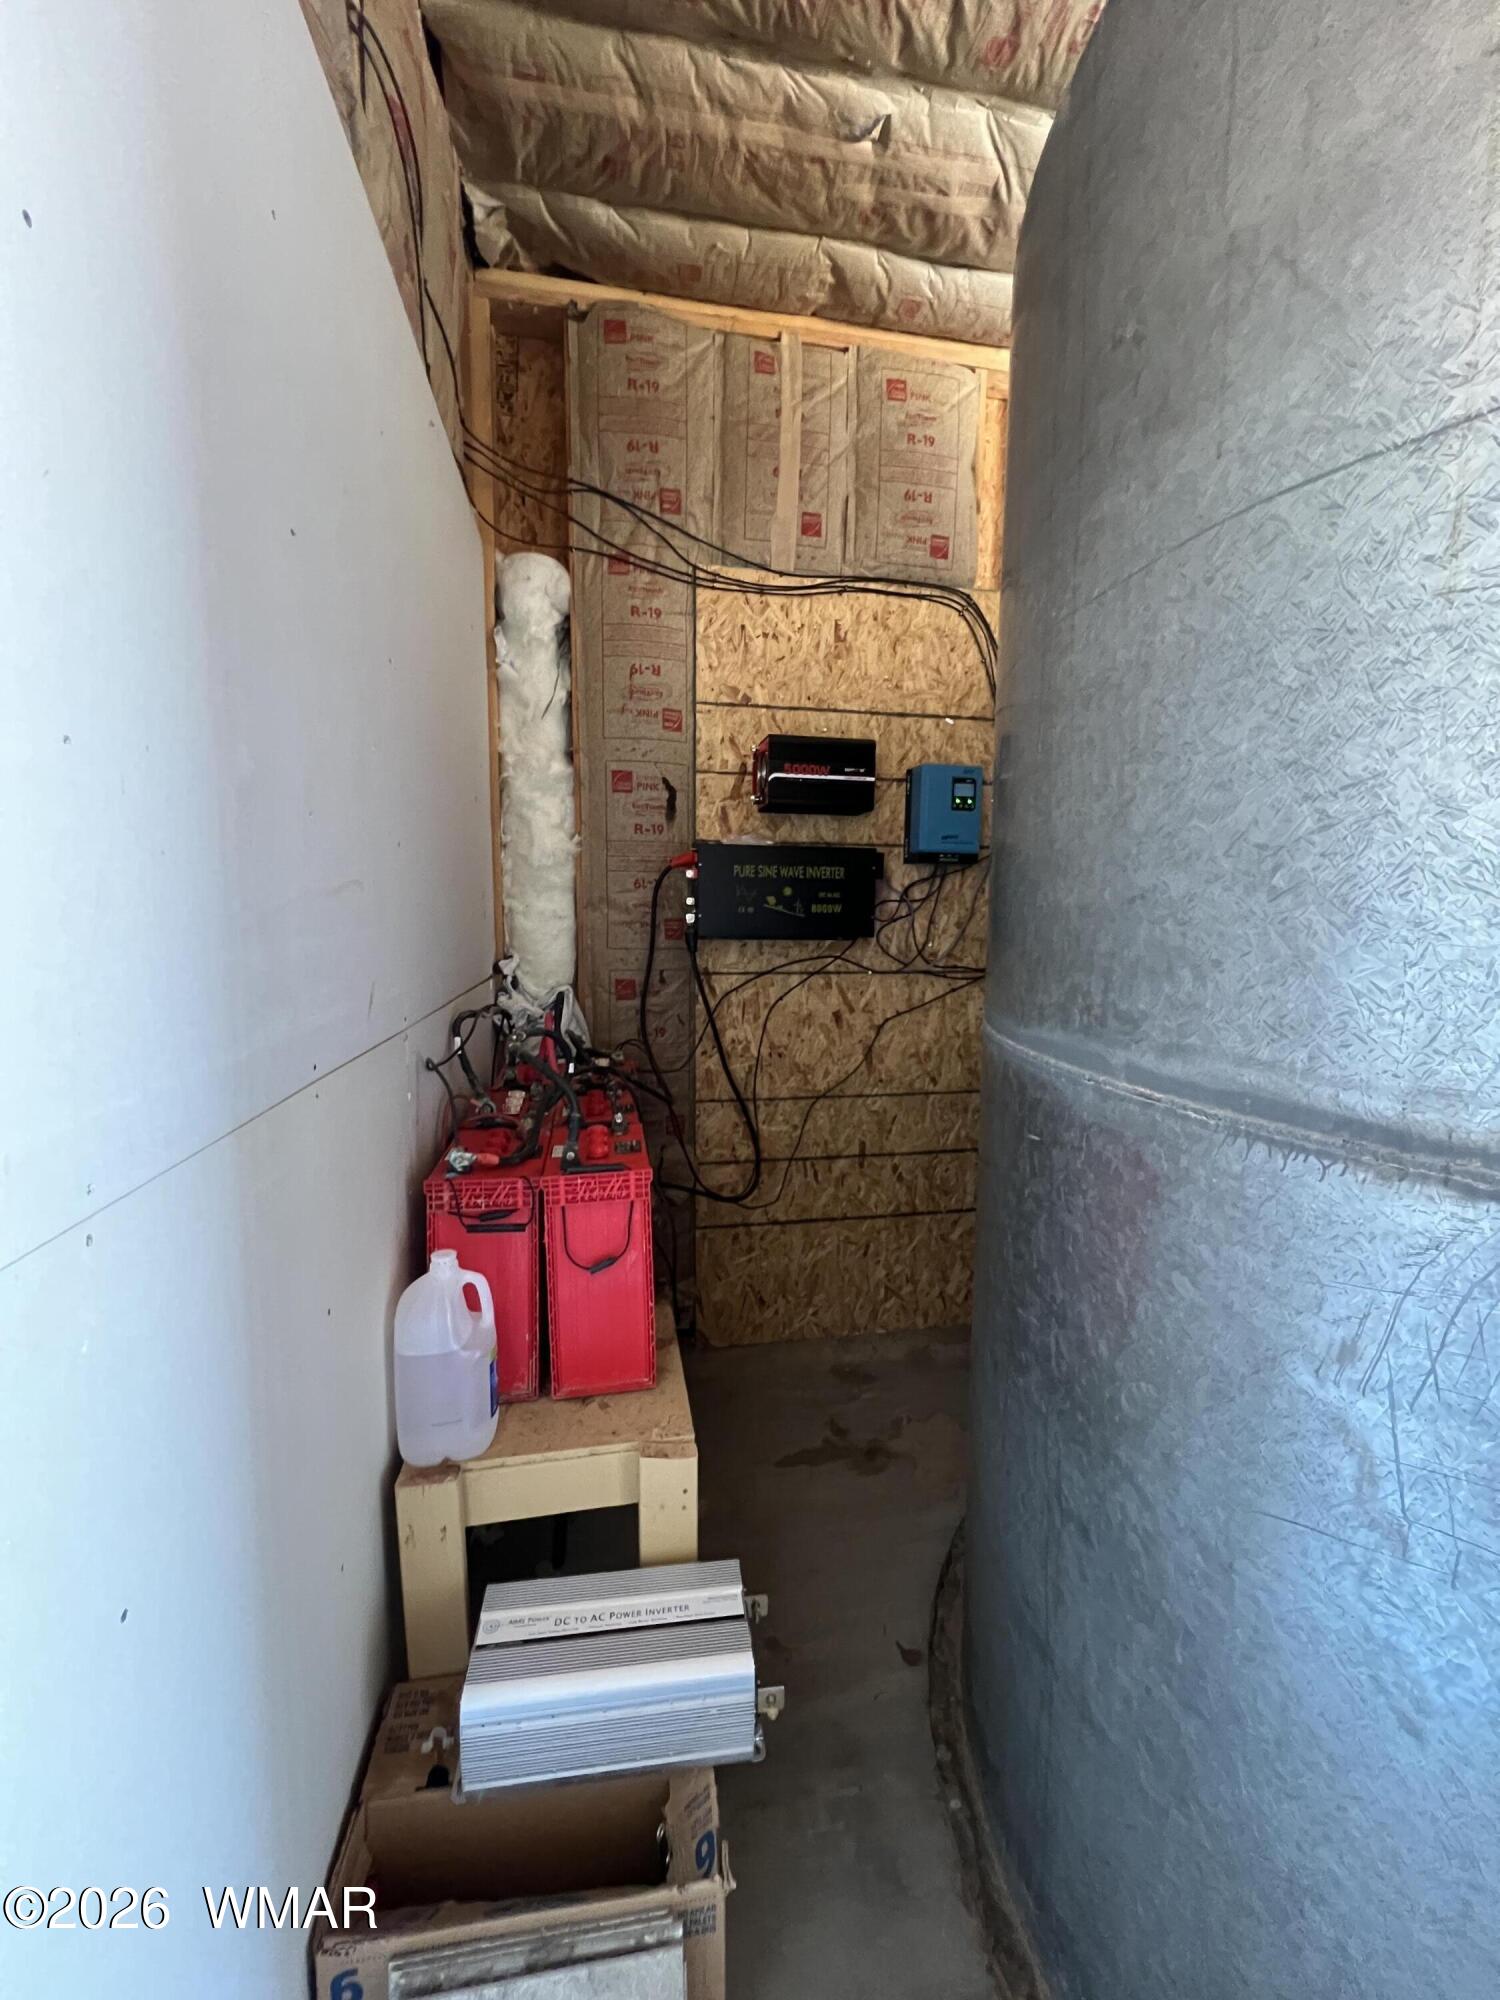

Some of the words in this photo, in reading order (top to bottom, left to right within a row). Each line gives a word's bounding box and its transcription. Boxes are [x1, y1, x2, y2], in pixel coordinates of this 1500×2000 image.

[627, 377, 660, 394] R-19
[906, 432, 936, 447] R-19
[904, 488, 933, 504] R-19
[630, 605, 662, 619] R-19
[629, 663, 661, 677] R-19
[636, 781, 660, 792] PINK
[633, 822, 665, 835] R-19
[733, 864, 756, 879] PURE
[757, 865, 779, 879] SINE
[780, 865, 805, 879] WAVE
[806, 866, 846, 880] INVERTER
[553, 1616, 572, 1627] DC
[574, 1615, 588, 1625] TO
[589, 1612, 606, 1623] AC
[608, 1609, 642, 1620] POWER
[644, 1603, 691, 1617] INVERTER
[329, 1967, 364, 2000] 6
